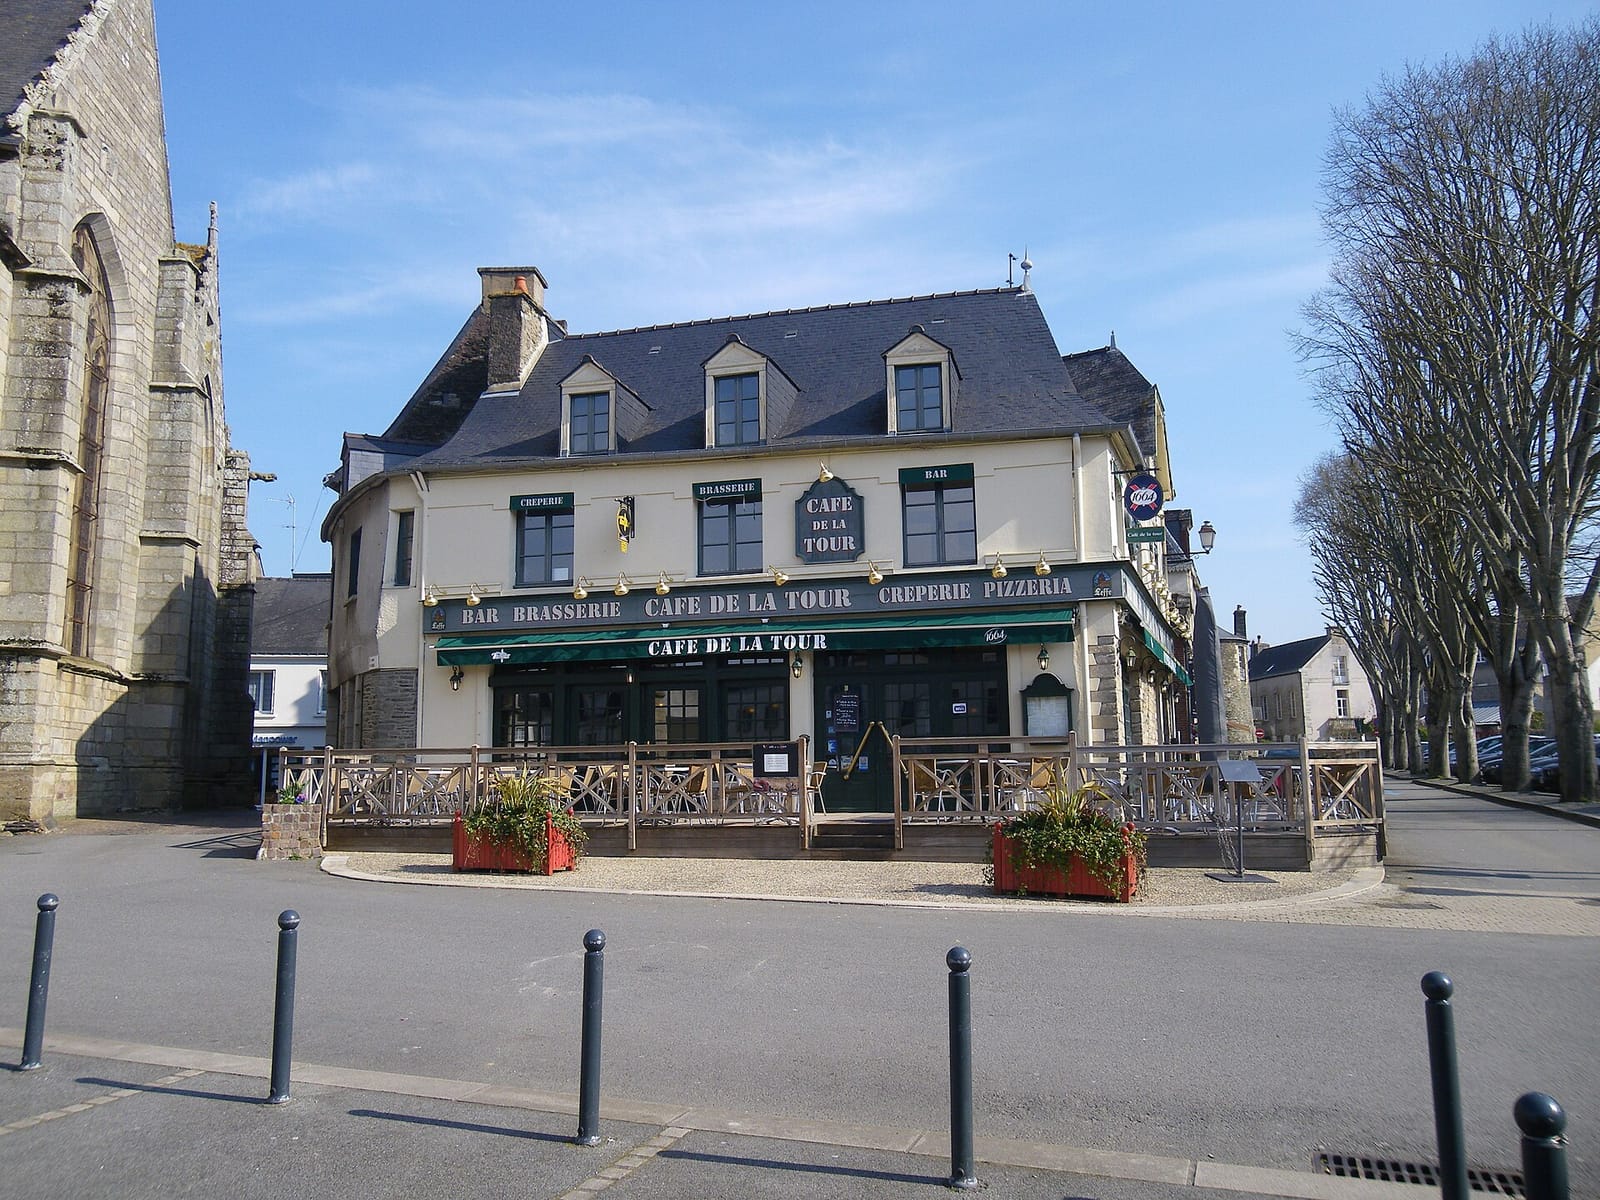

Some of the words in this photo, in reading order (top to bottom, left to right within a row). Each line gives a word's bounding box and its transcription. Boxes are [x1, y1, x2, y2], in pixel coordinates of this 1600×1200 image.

[925, 470, 947, 479] BAR
[699, 482, 756, 495] BRASSERIE
[520, 496, 564, 507] CREPERIE
[1131, 491, 1155, 502] 1664
[806, 496, 853, 514] CAFE
[812, 520, 828, 531] DE
[832, 518, 846, 529] LA
[804, 535, 856, 554] TOUR
[1094, 587, 1112, 597] Leffe
[461, 607, 499, 625] BAR
[513, 602, 621, 622] BRASSERIE
[645, 595, 700, 616] CAFE
[709, 593, 740, 614] DE
[748, 591, 777, 612] LA
[785, 588, 852, 610] TOUR
[879, 583, 971, 603] CREPERIE
[984, 578, 1072, 598] PIZZERIA
[431, 621, 446, 631] Leffe
[985, 630, 1006, 642] 1664
[648, 639, 698, 656] CAFE
[706, 637, 731, 653] DE
[739, 636, 763, 651] LA
[770, 634, 827, 651] TOUR
